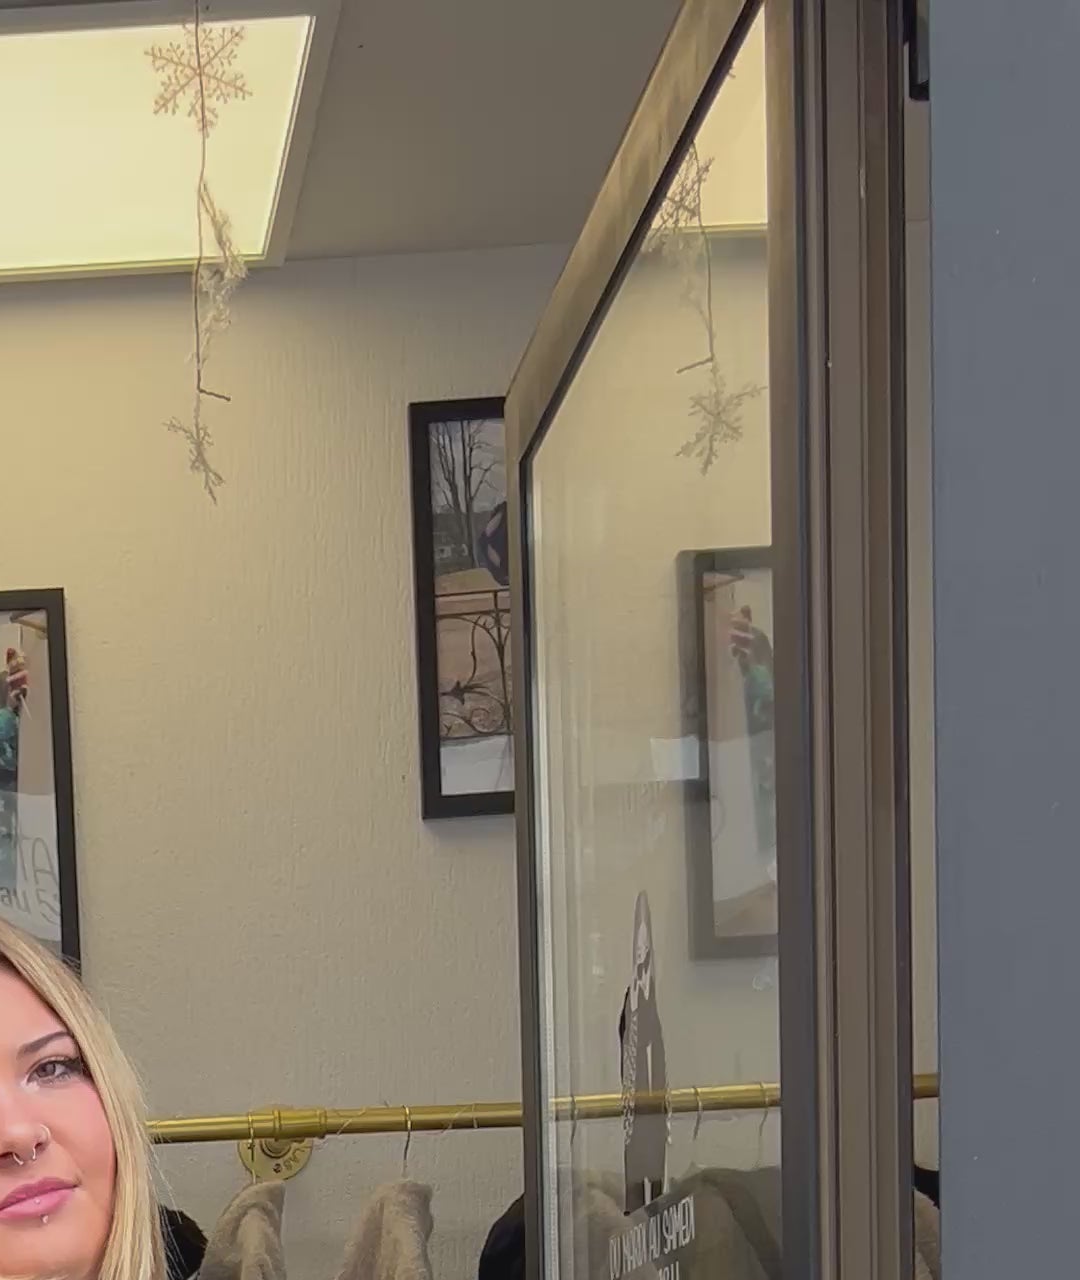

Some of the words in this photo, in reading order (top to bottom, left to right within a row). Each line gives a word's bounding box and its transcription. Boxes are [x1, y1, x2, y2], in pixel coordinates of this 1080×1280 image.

[622, 1222, 647, 1275] MARDI
[648, 1214, 662, 1262] AU
[662, 1195, 696, 1255] SAMEDI
